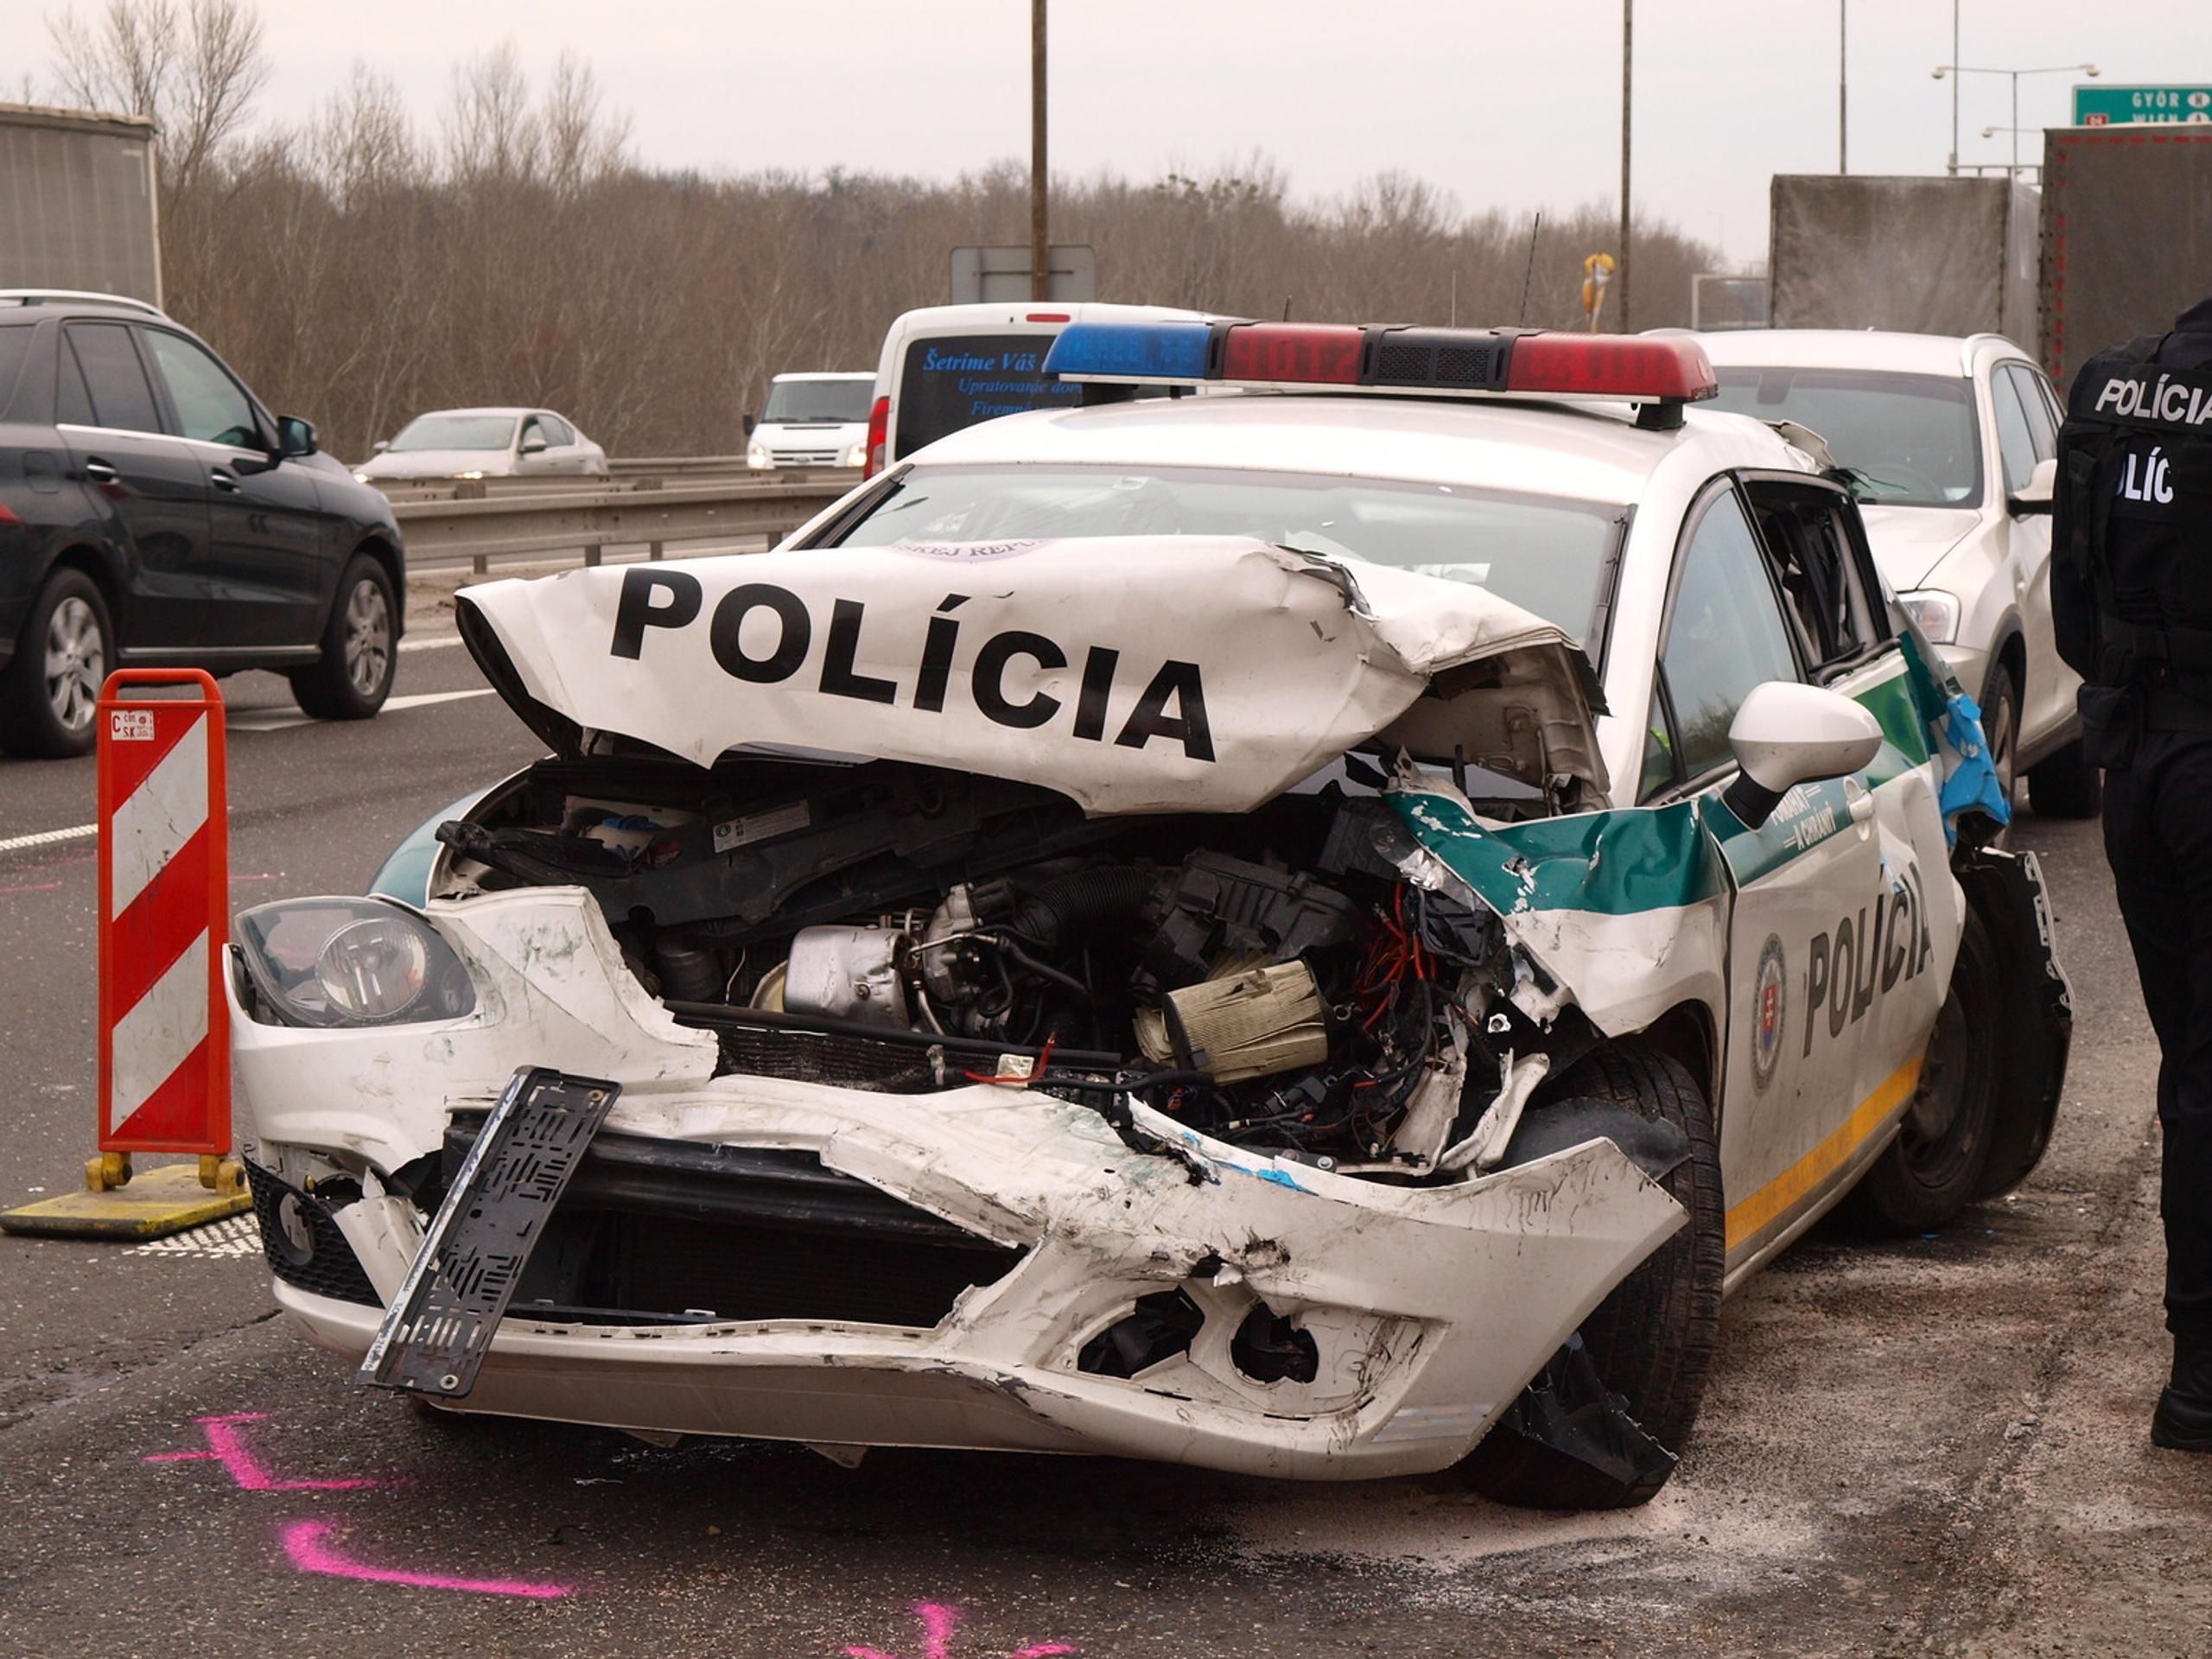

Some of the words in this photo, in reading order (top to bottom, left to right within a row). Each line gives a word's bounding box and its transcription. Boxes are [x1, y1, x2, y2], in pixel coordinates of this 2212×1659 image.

[1002, 353, 1037, 372] Váš
[2117, 446, 2174, 504] LÍC
[610, 568, 1216, 762] POLÍCIA
